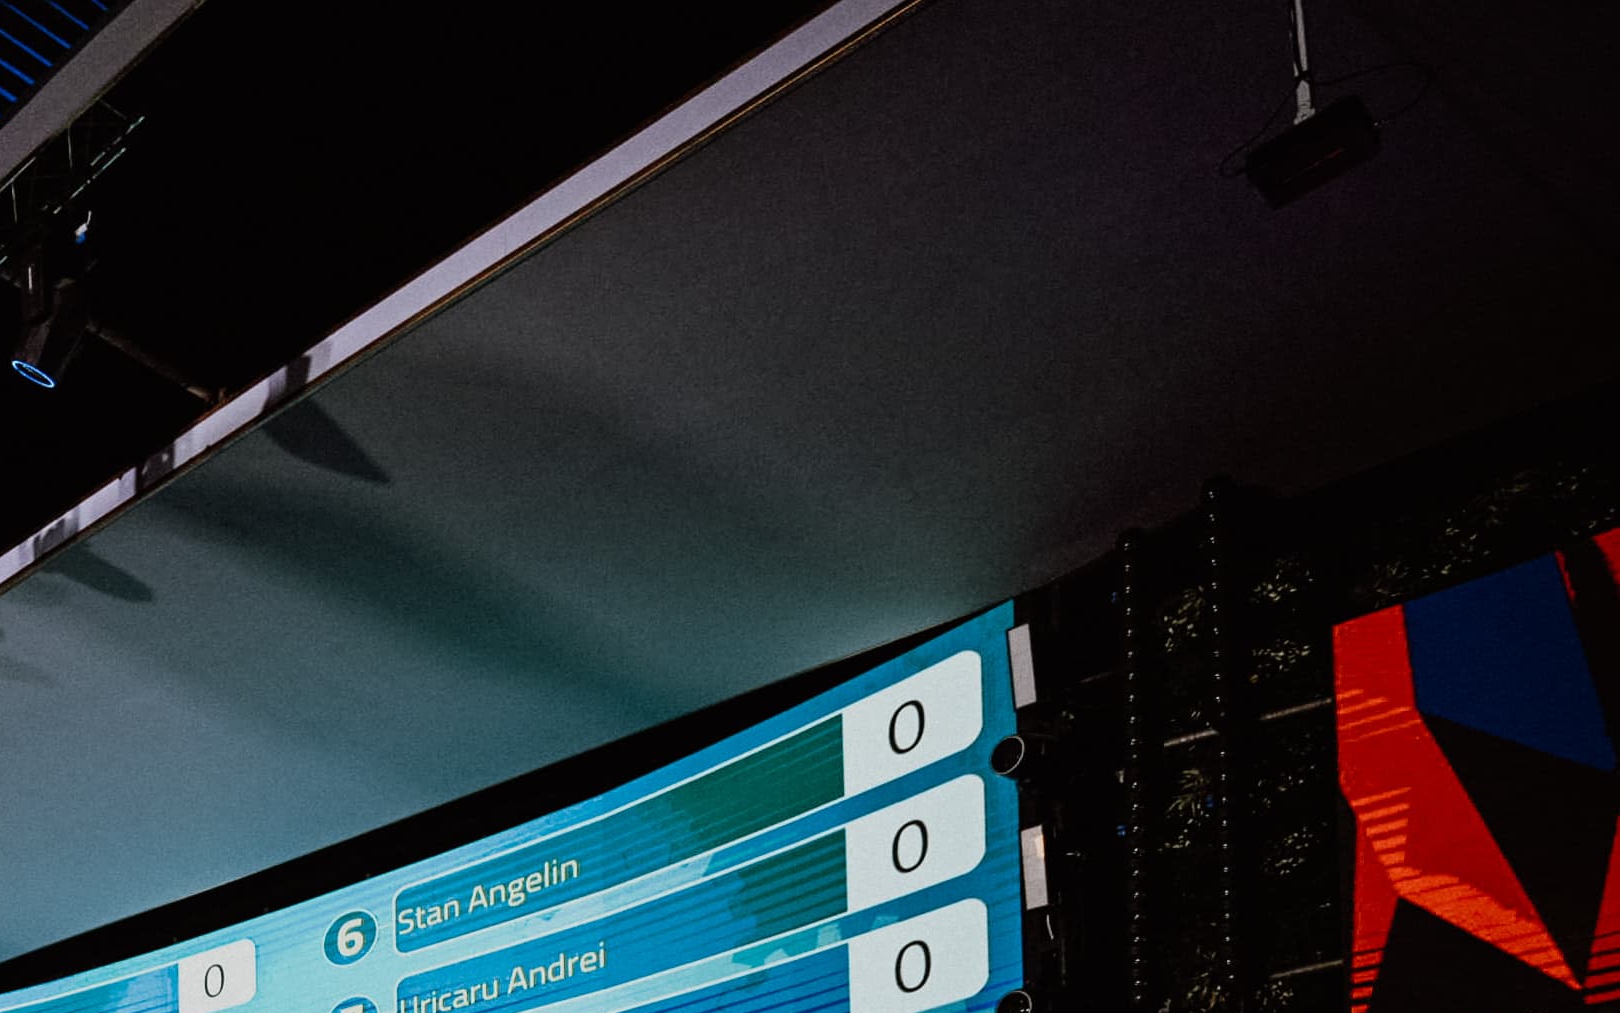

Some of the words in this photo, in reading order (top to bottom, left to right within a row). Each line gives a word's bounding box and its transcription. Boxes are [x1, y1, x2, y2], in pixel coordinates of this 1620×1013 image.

[337, 918, 365, 957] 6
[398, 899, 461, 935] Stan
[468, 859, 579, 912] Angelin
[888, 699, 925, 754] 0
[507, 941, 607, 994] Andrei
[891, 819, 928, 873] 0
[204, 964, 224, 998] 0
[894, 940, 931, 993] 0
